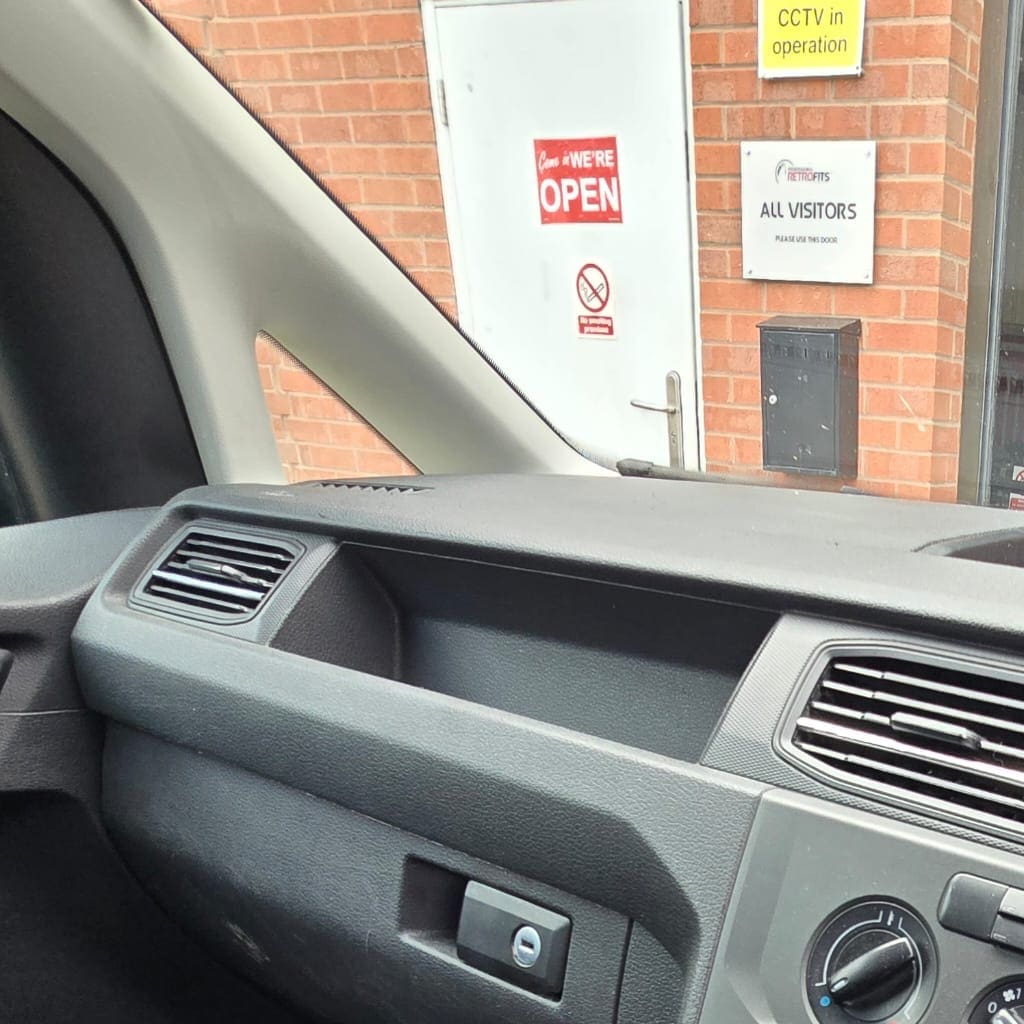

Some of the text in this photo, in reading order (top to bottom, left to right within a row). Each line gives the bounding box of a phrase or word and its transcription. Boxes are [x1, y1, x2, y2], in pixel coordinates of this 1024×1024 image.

[778, 7, 843, 27] CCTV in
[772, 34, 848, 59] operation
[569, 149, 615, 169] WE'RE
[787, 171, 830, 182] RETROFITS
[540, 177, 620, 213] OPEN
[760, 201, 857, 220] ALL VISITORS
[987, 1001, 998, 1014] 0
